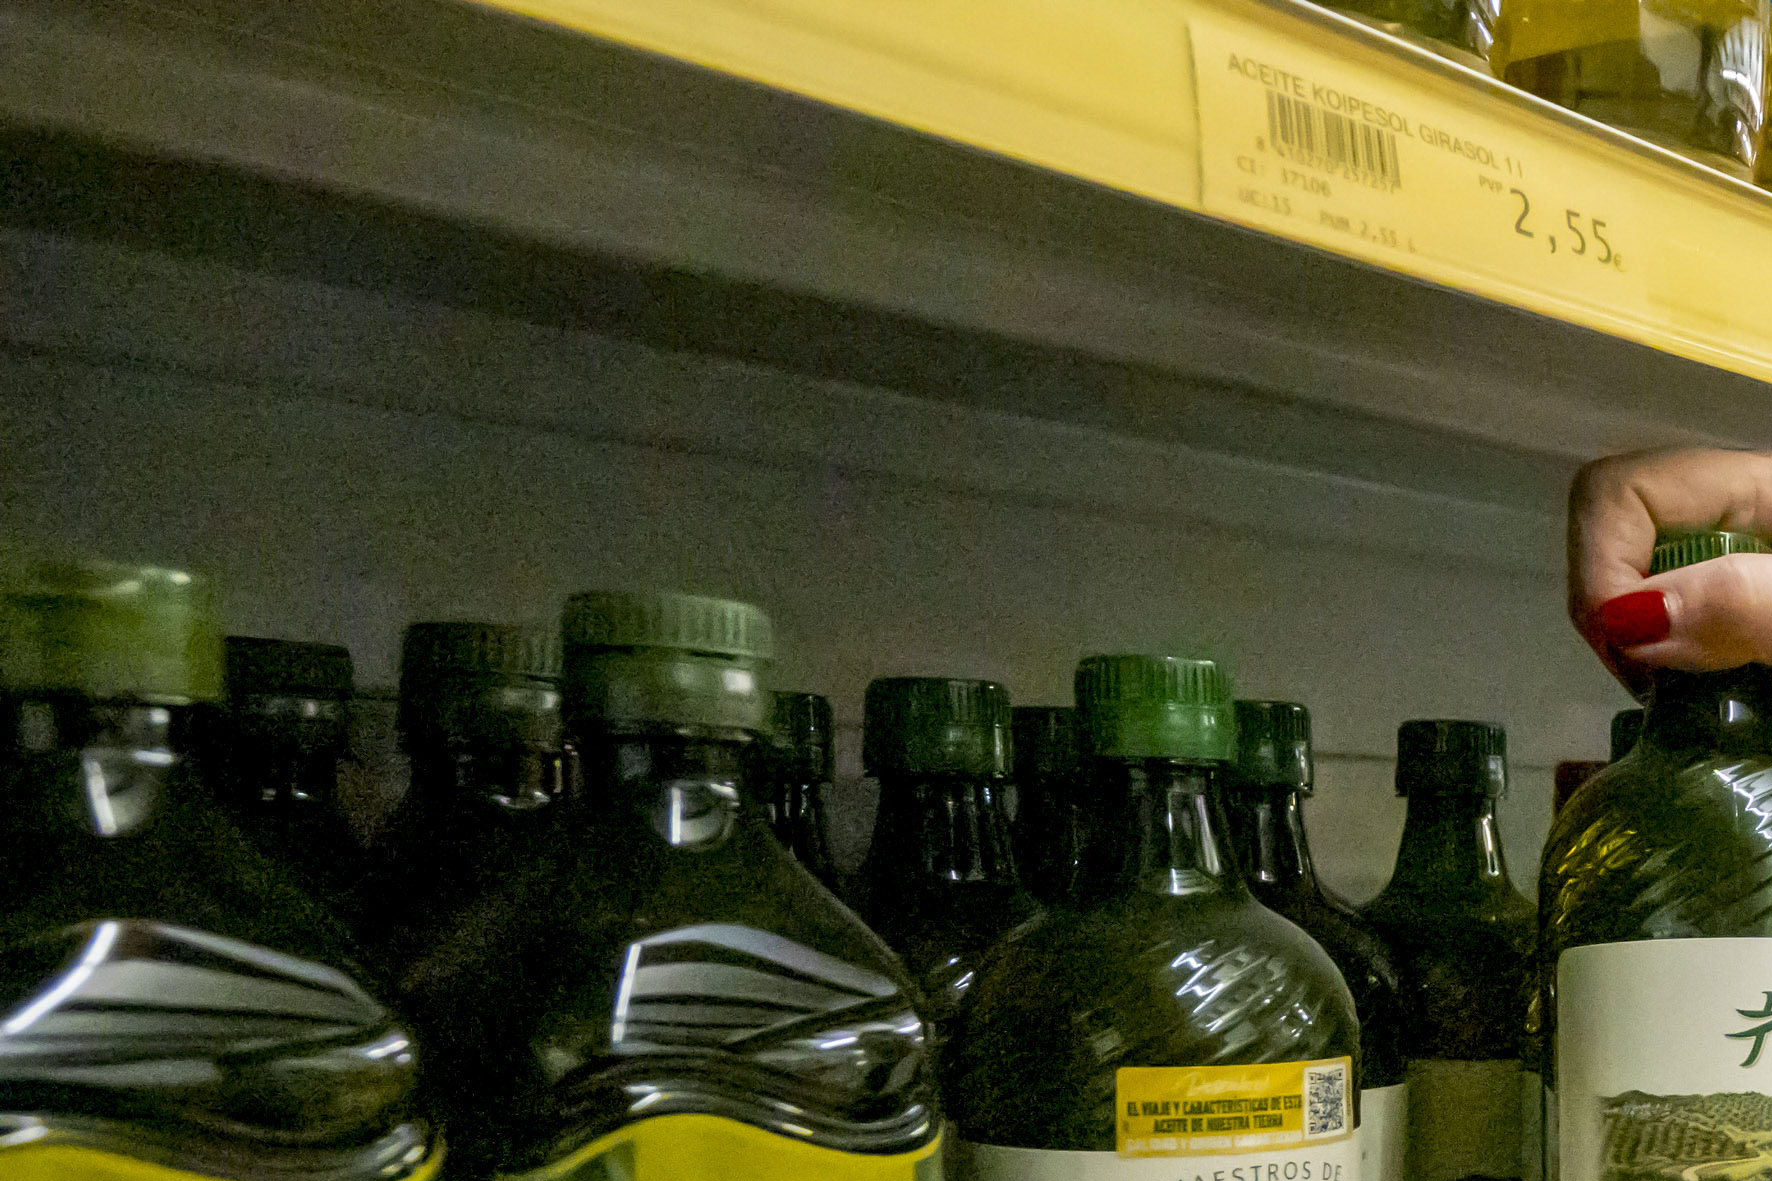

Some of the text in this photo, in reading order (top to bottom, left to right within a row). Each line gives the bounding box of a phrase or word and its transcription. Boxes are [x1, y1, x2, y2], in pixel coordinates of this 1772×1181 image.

[1228, 52, 1307, 98] ACEITE
[1312, 83, 1414, 138] KOIPESOL
[1419, 123, 1500, 170] GIRASOL
[1479, 174, 1502, 193] PVP
[1127, 1101, 1139, 1117] EL
[1142, 1100, 1171, 1116] VIAJE
[1172, 1101, 1179, 1116] Y
[1269, 1096, 1282, 1110] DE
[1153, 1113, 1283, 1133] ACEITE DE NUESTRA TIERRA
